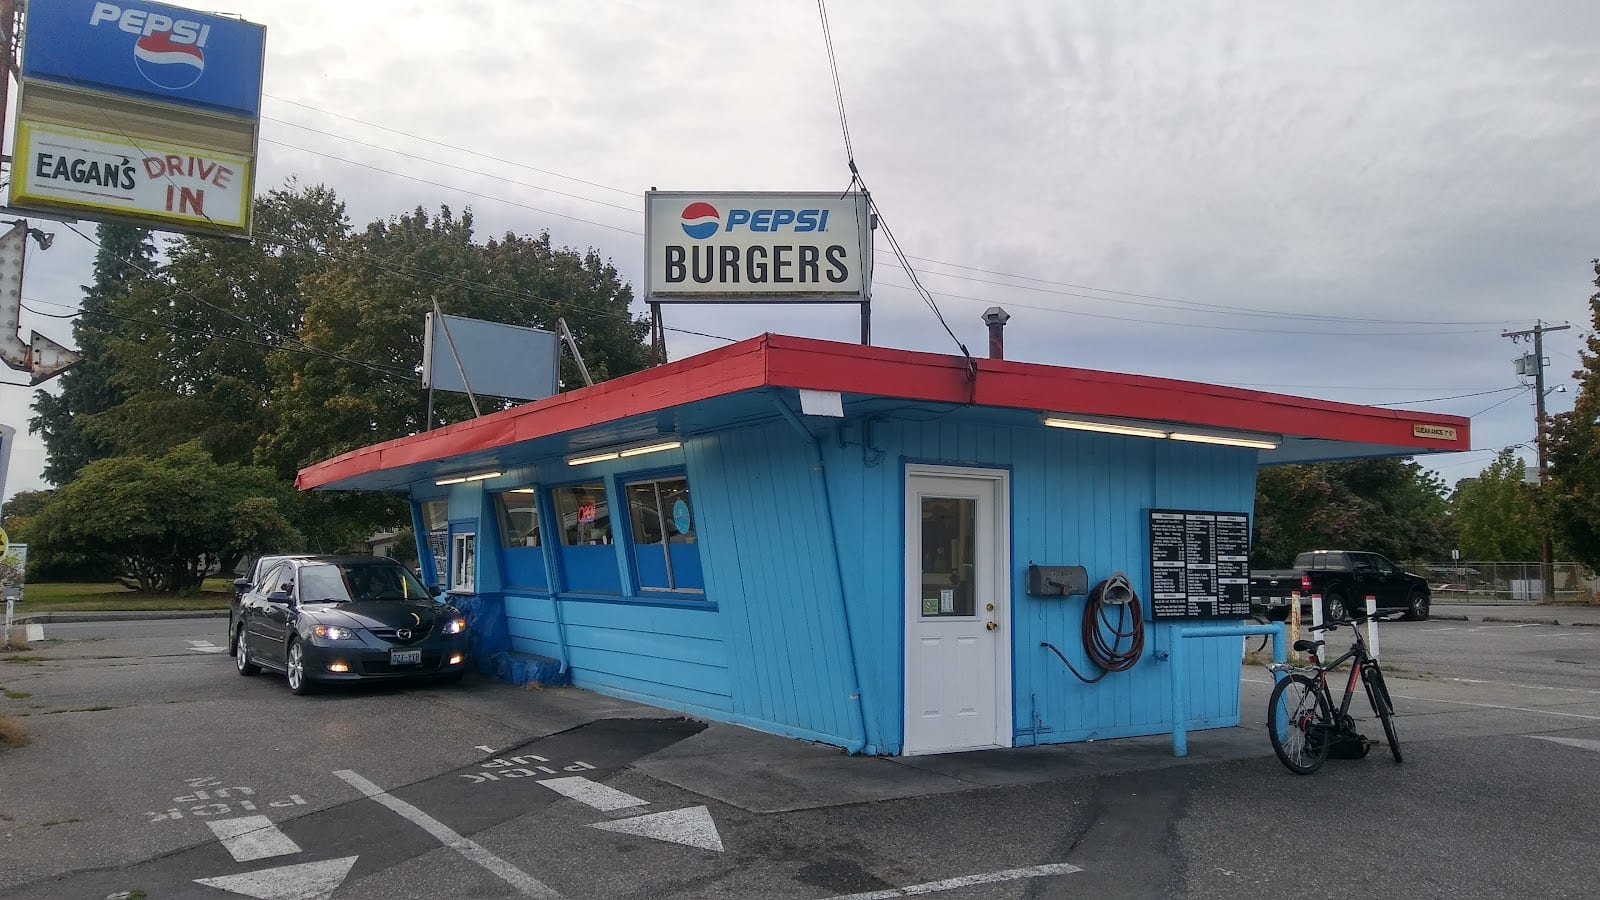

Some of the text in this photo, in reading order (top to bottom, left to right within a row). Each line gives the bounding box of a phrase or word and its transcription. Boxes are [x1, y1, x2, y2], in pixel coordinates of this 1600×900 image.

[90, 2, 210, 48] PEPSI
[36, 153, 233, 190] EAGAN'S DRIVE
[165, 185, 204, 215] IN
[725, 209, 829, 232] PEPSI
[665, 245, 849, 283] BURGERS
[460, 761, 597, 783] PICK
[481, 754, 550, 768] UP
[145, 794, 307, 822] PICK
